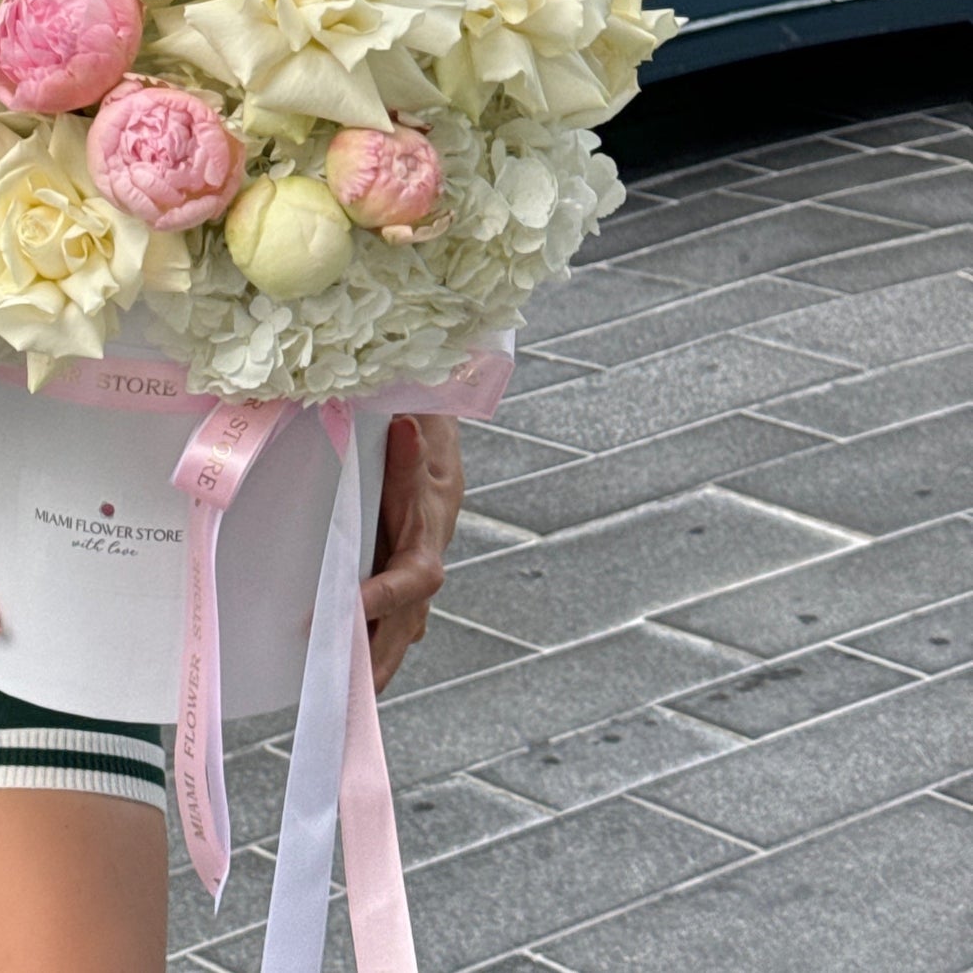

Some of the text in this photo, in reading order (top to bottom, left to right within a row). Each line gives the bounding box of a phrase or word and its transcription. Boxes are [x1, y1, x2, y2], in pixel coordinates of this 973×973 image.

[96, 372, 178, 397] STORE
[197, 415, 249, 491] STORE
[34, 507, 185, 543] MIAMI FLOWER STORE
[71, 536, 139, 557] with love
[183, 653, 202, 758] FLOWER
[183, 772, 207, 842] MIAMI
